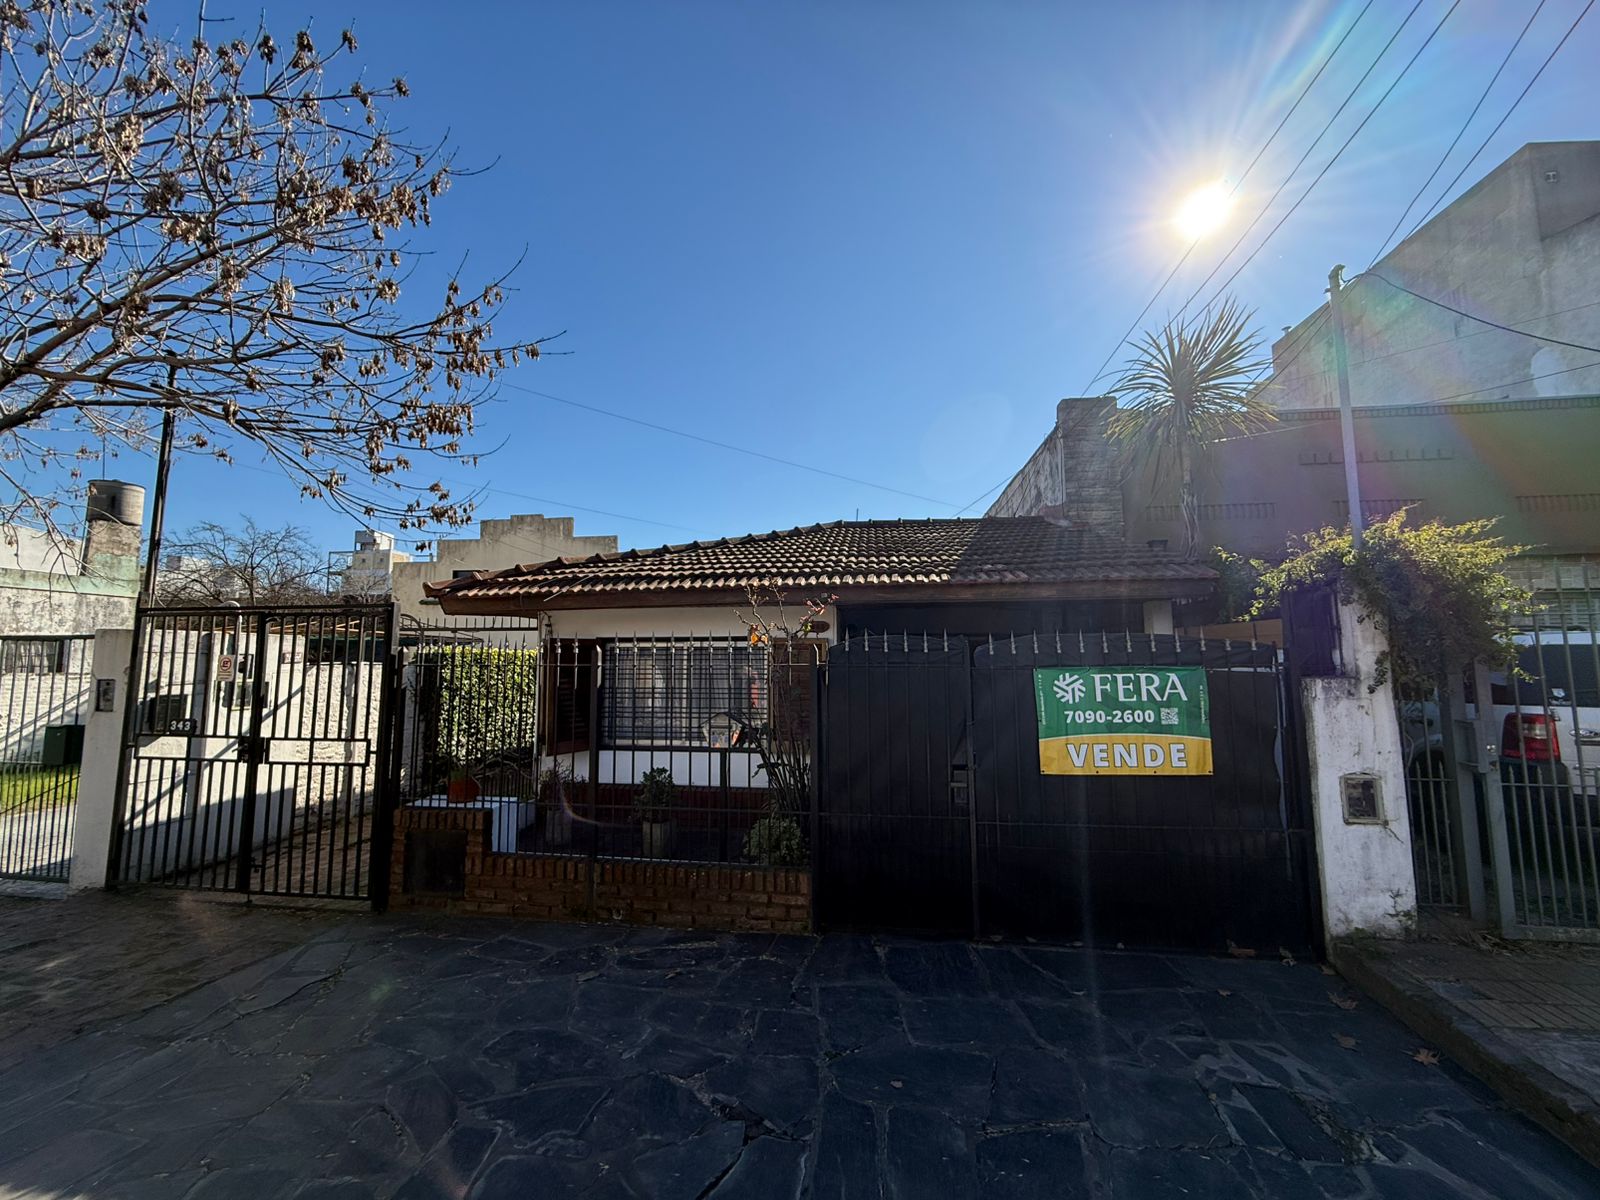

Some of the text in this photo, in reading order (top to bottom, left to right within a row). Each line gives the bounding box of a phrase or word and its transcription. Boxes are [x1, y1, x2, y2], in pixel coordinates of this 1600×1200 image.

[1091, 673, 1188, 702] FERA
[170, 721, 191, 730] 343
[1064, 710, 1155, 723] 7090-2600
[1066, 743, 1187, 768] VENDE
